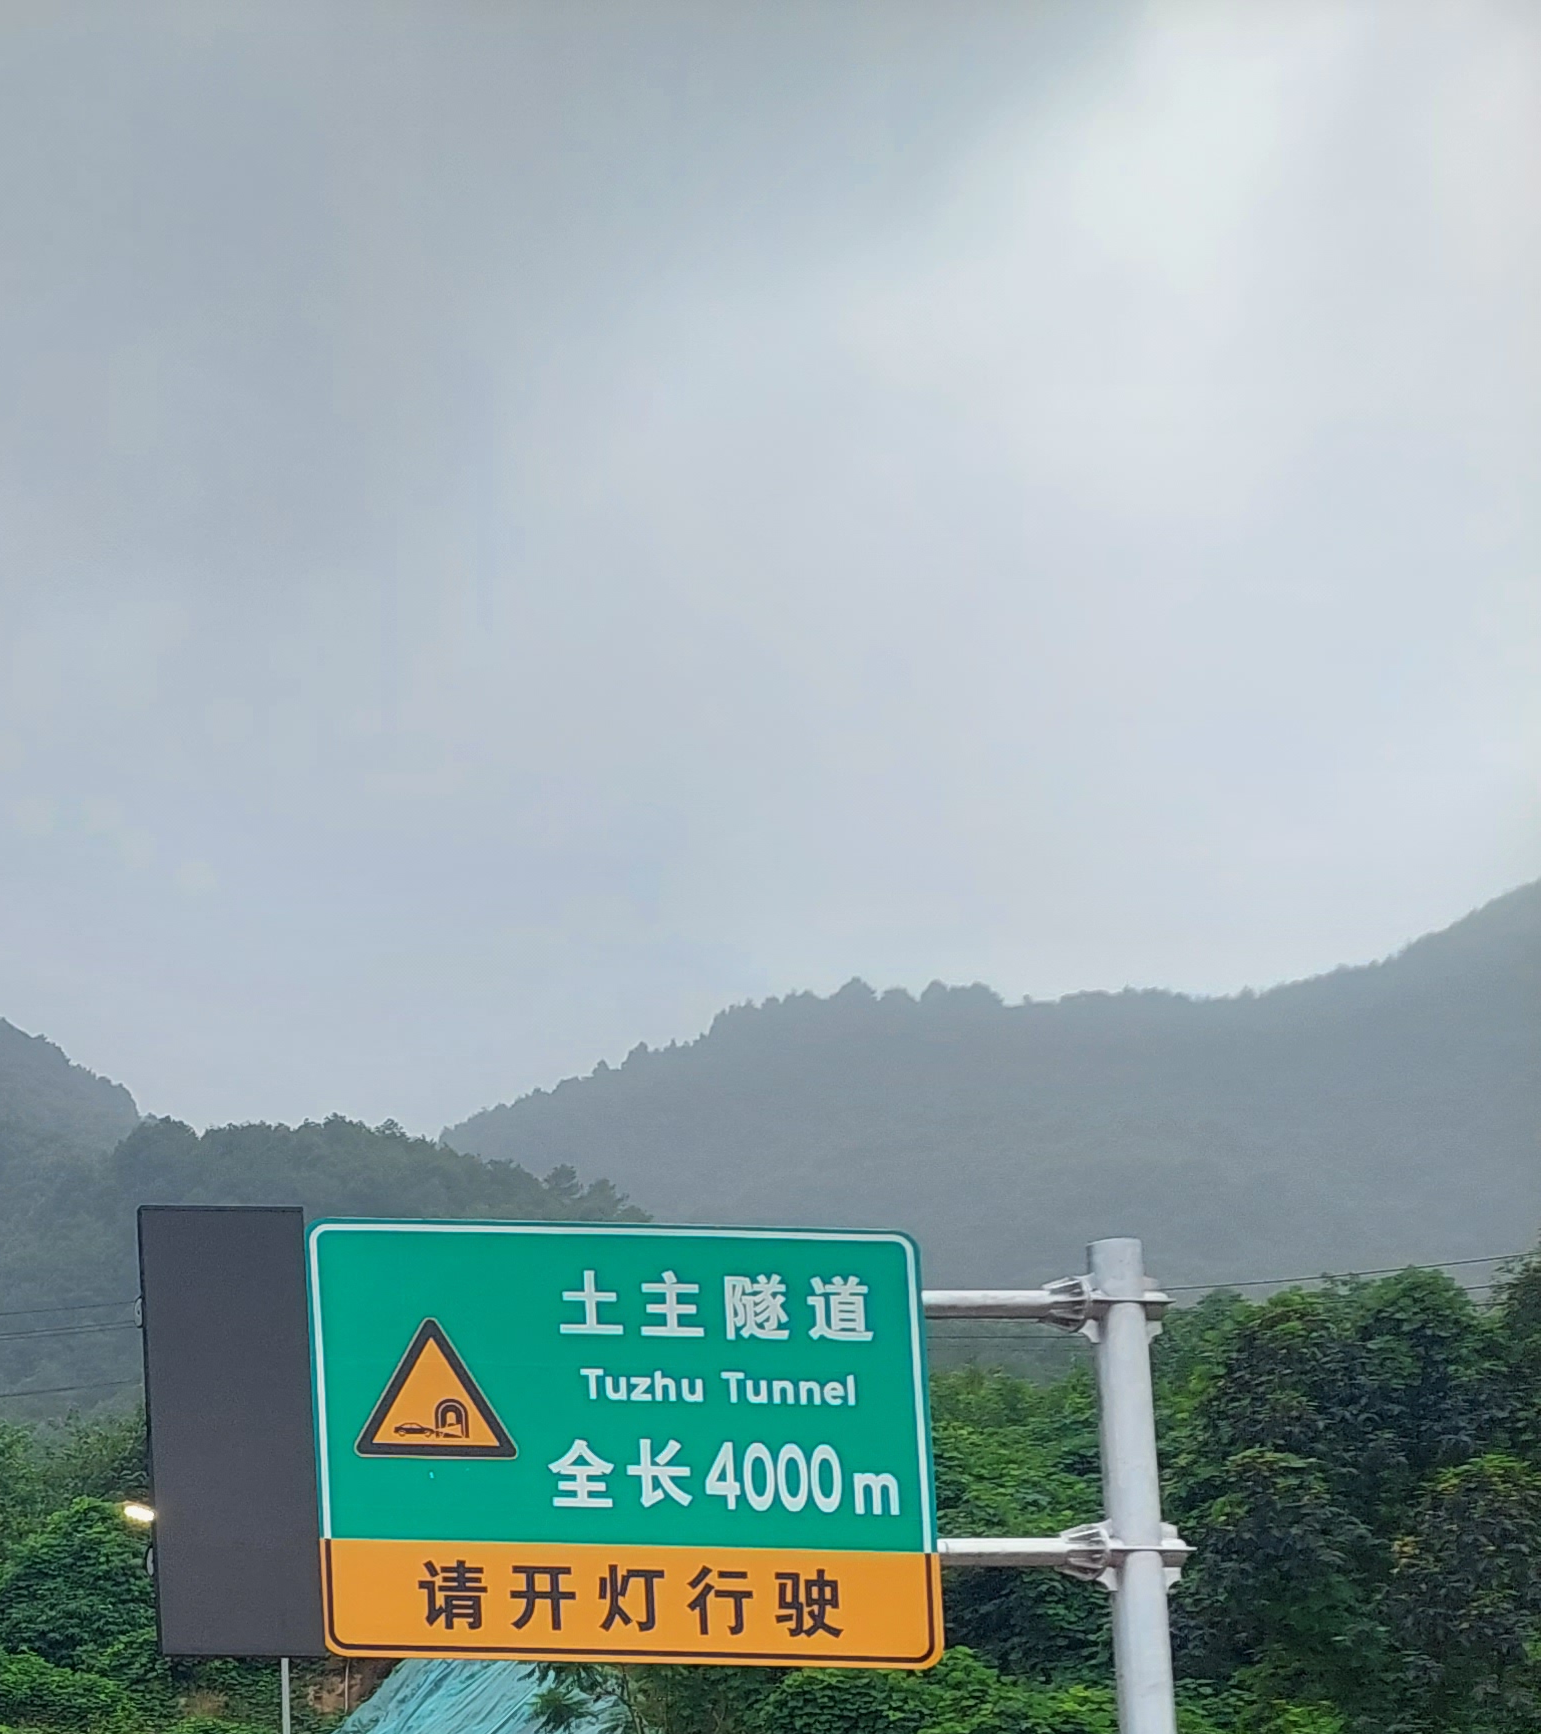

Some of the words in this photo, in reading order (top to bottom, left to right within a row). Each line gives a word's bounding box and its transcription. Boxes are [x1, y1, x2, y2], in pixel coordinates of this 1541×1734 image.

[559, 1269, 874, 1342] 土主隧道
[580, 1368, 704, 1403] Tuzhu
[721, 1370, 857, 1406] Tunnel
[547, 1438, 901, 1517] 全长4000m
[418, 1559, 843, 1639] 请开灯行驶
